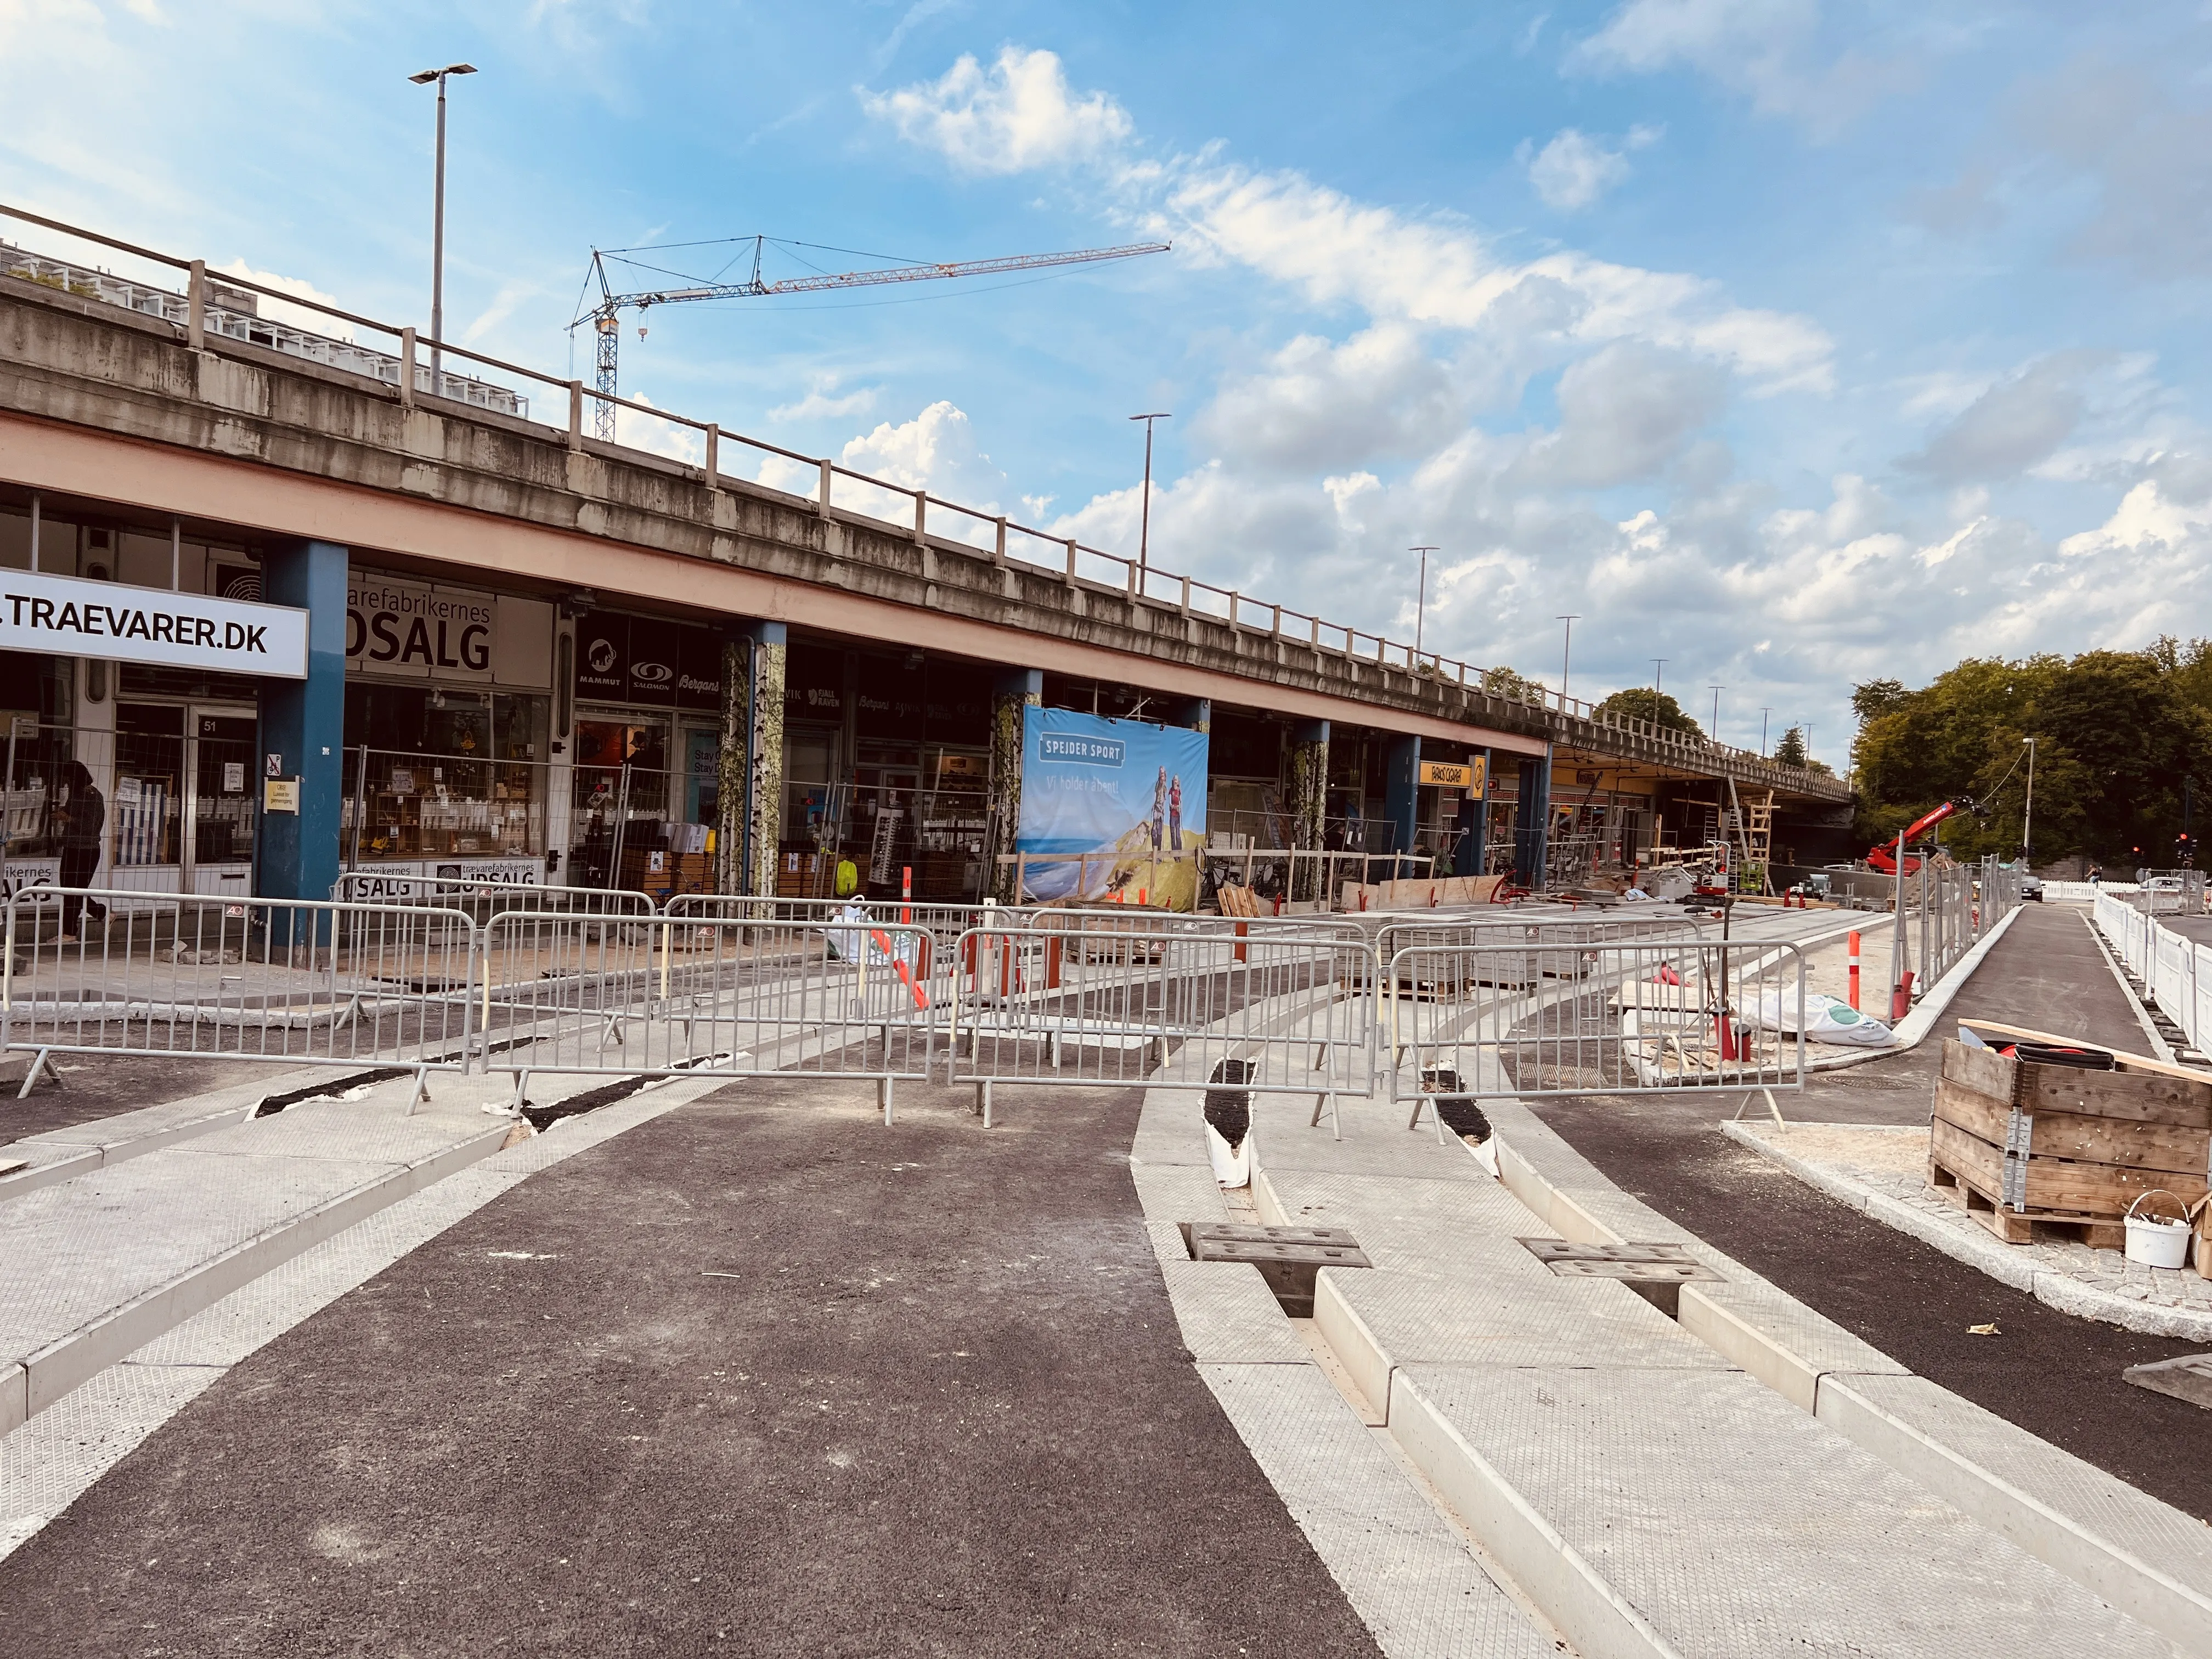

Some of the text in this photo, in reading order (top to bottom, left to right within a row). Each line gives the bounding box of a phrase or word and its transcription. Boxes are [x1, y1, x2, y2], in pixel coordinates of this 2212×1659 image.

[347, 588, 490, 623] arefabrikernes
[579, 675, 621, 686] MAMMUT
[678, 674, 720, 693] Bergans
[633, 681, 670, 691] SALOMON
[204, 721, 216, 732] 51
[1046, 740, 1120, 760] SPEJDER SPORT
[695, 749, 714, 763] Stay
[694, 762, 714, 775] Stay
[1047, 775, 1056, 790] Vi
[1060, 775, 1088, 791] holder
[462, 863, 534, 873] trævarefabrikernes
[479, 889, 490, 898] AO
[226, 906, 243, 915] AO
[698, 927, 714, 936] AO
[1527, 927, 1538, 936] AO
[1150, 941, 1165, 951] AO
[1582, 952, 1596, 961] AO
